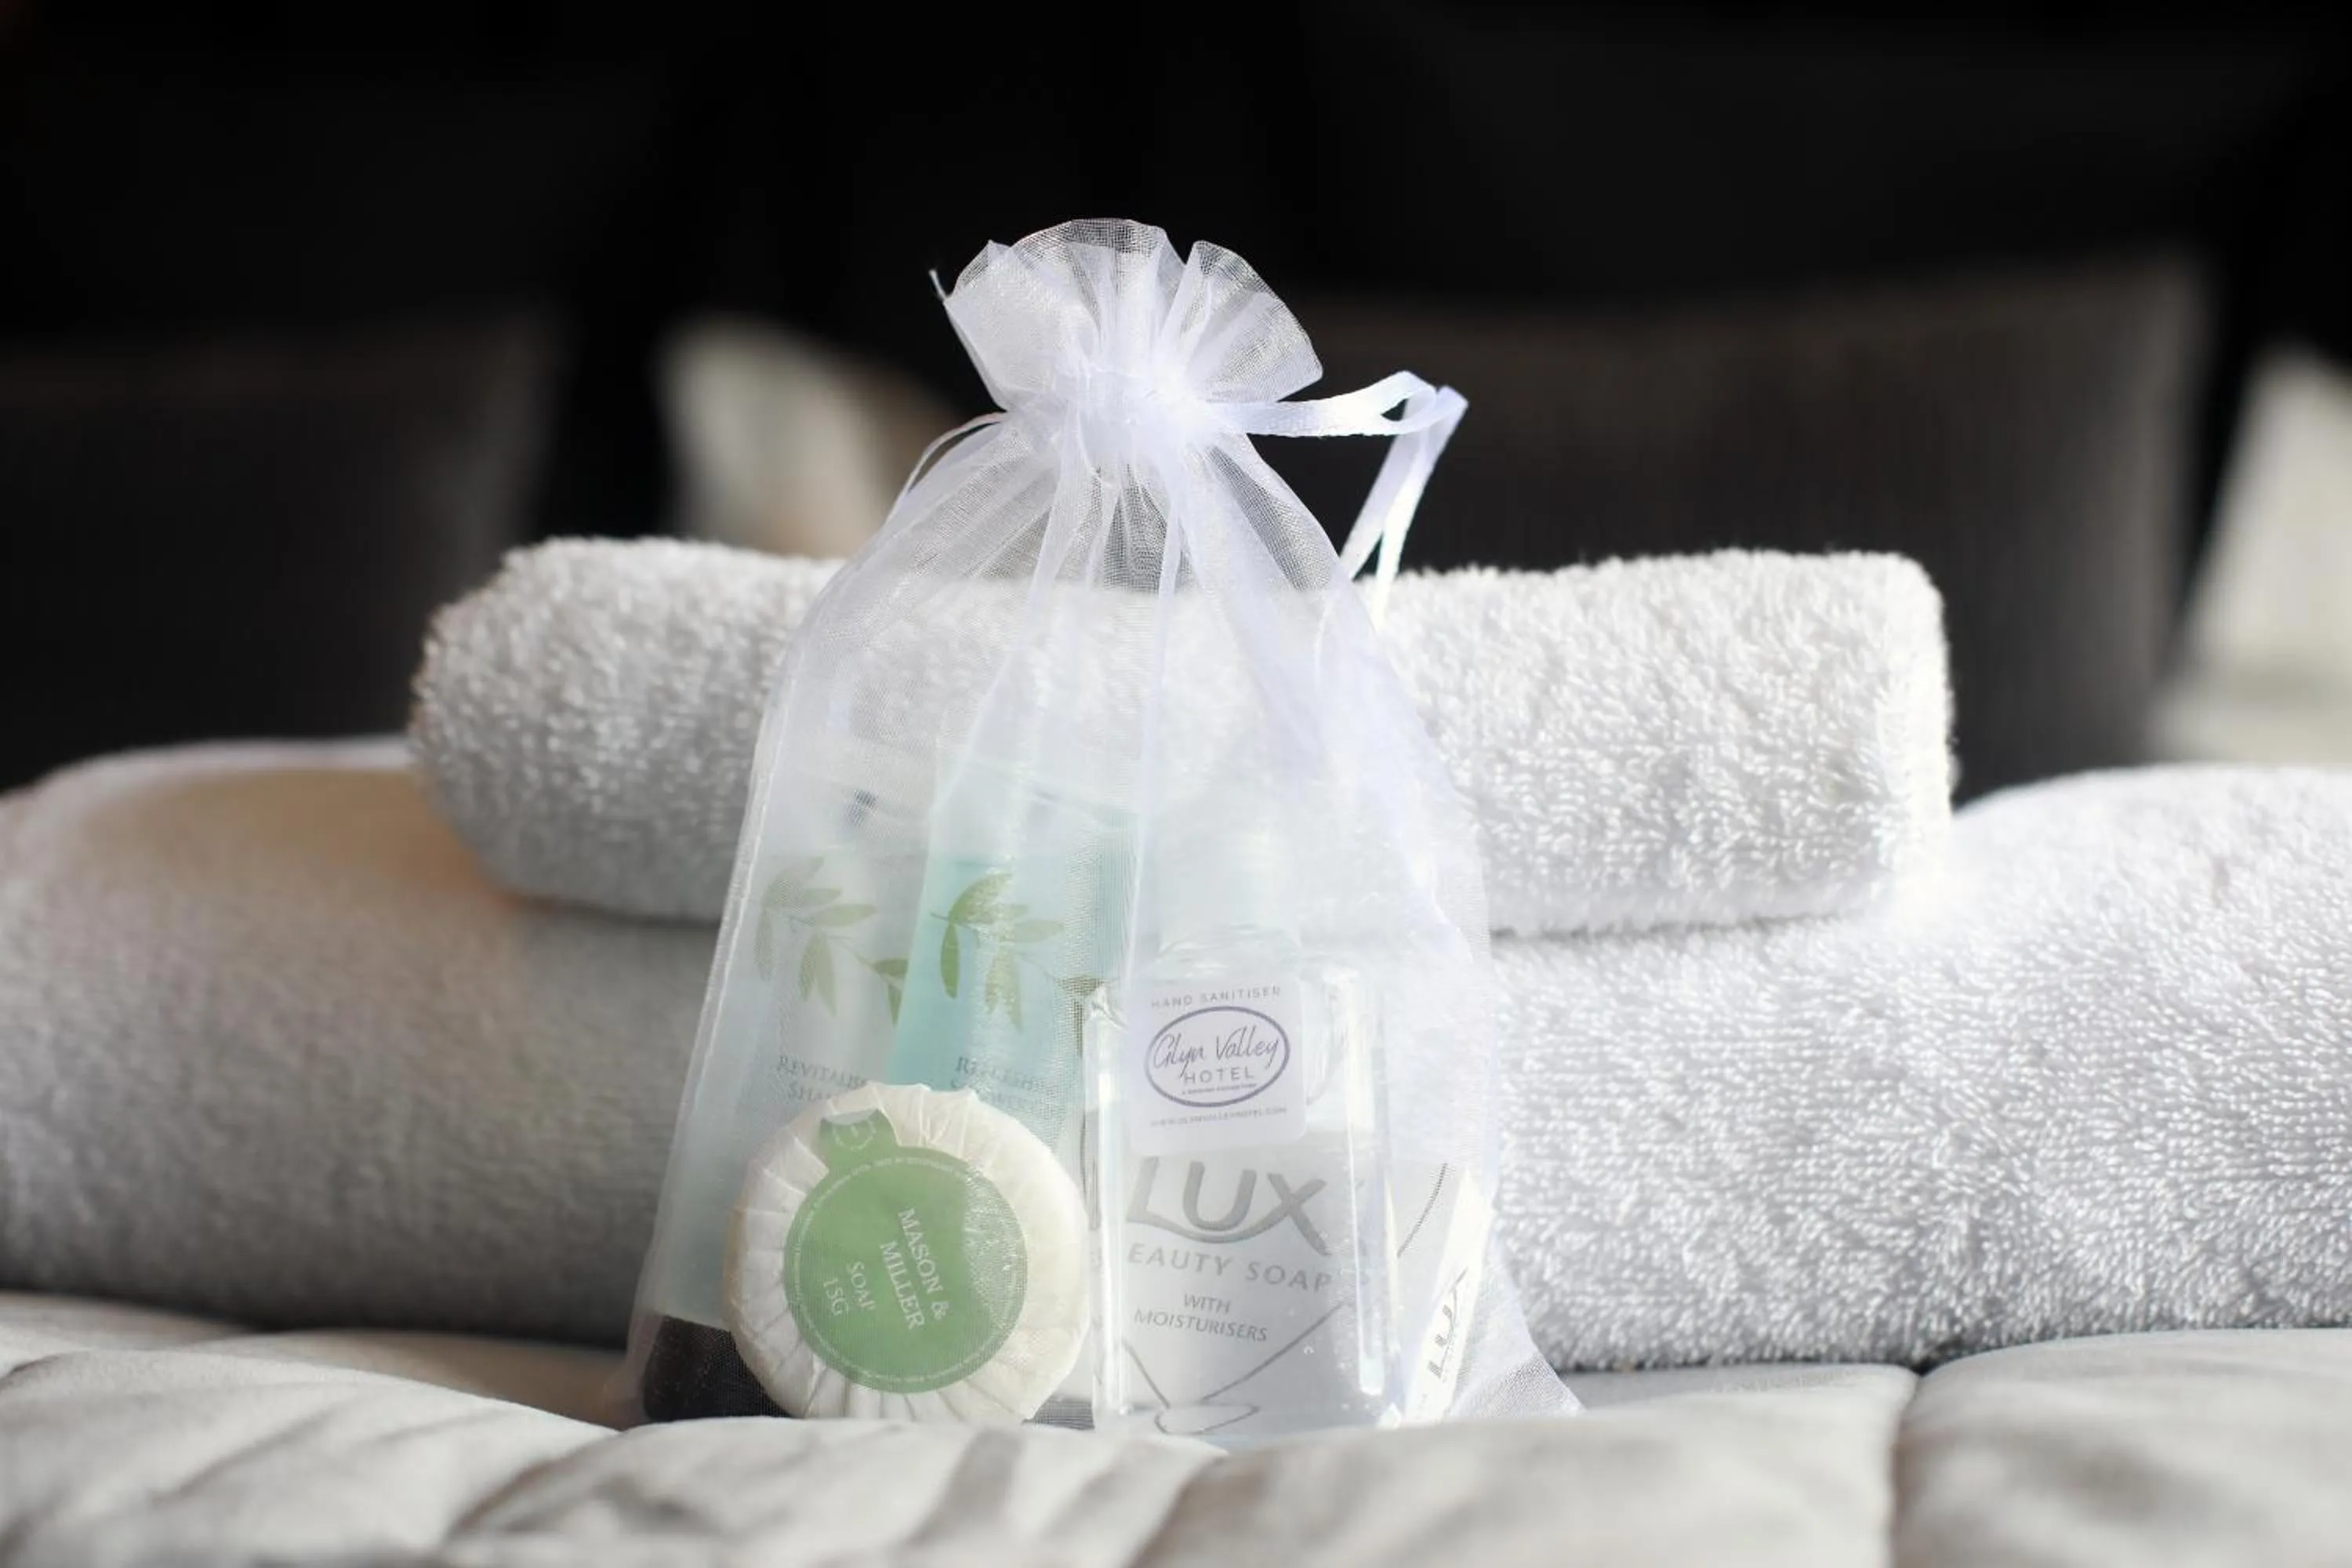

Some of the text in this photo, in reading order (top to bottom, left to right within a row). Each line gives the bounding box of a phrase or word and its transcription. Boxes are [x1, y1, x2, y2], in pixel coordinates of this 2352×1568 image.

[1151, 985, 1281, 1009] HAND SANITISER
[1153, 1025, 1279, 1078] Glyn Valley
[1184, 1065, 1255, 1085] HOTEL
[1126, 1156, 1331, 1256] LUX
[899, 1207, 950, 1322] MASON &
[1245, 1259, 1331, 1293] SOAP
[879, 1240, 926, 1330] MILLER
[1184, 1292, 1231, 1315] WITH
[1134, 1308, 1268, 1342] MOISTURISERS
